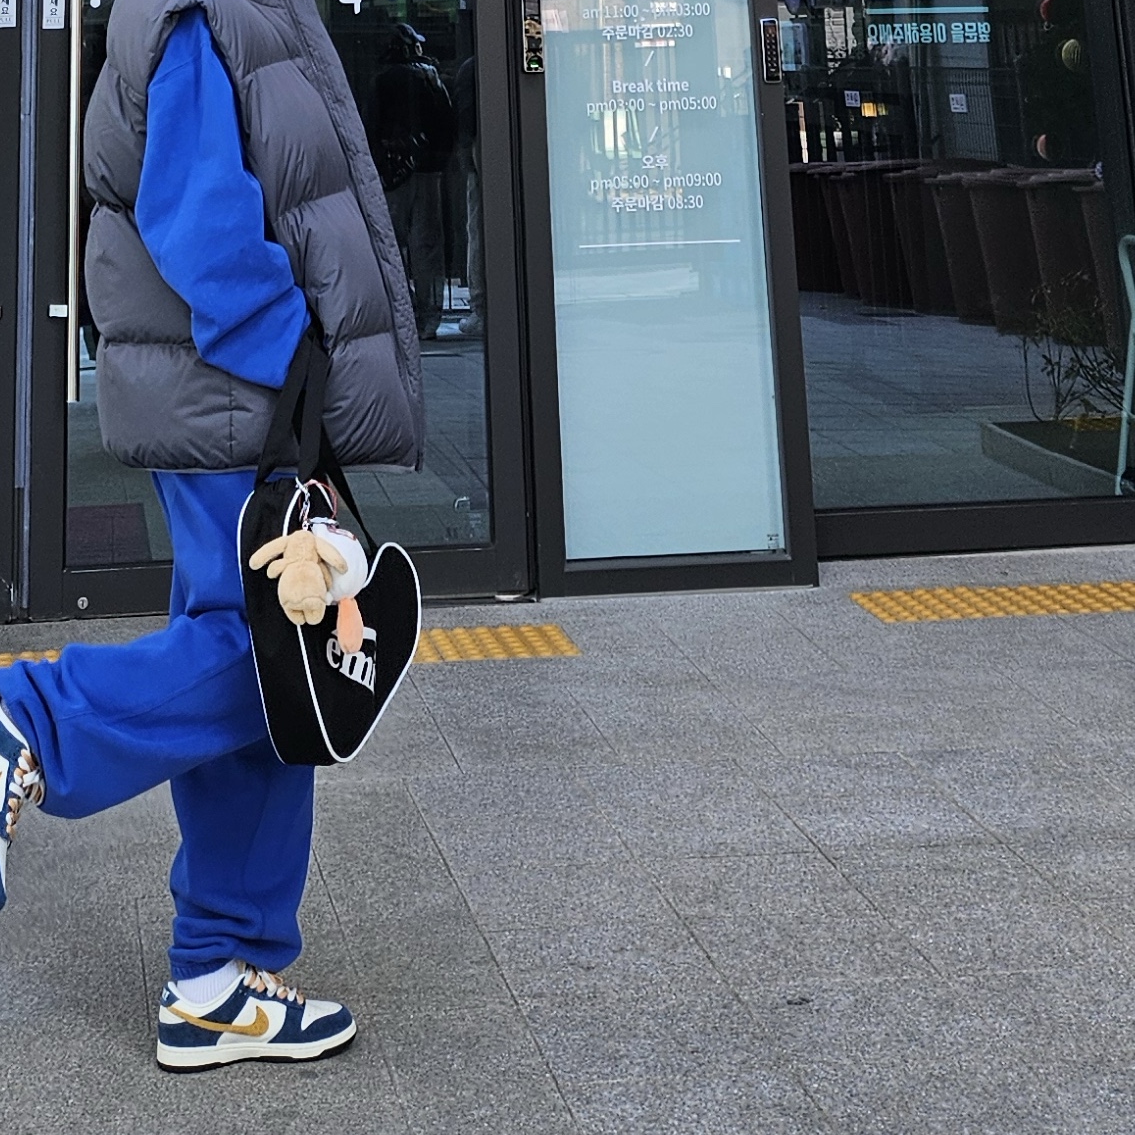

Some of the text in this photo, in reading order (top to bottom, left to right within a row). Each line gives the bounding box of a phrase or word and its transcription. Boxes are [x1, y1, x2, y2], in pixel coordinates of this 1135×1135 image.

[602, 24, 693, 41] 주문마감 02:30
[612, 78, 690, 93] Break time
[586, 98, 645, 116] pm03:00
[659, 96, 717, 114] pm05:00
[642, 154, 668, 170] 오후
[590, 175, 649, 194] pm05:00
[664, 172, 722, 190] pm09:00
[611, 195, 703, 212] 주문마감 08:30
